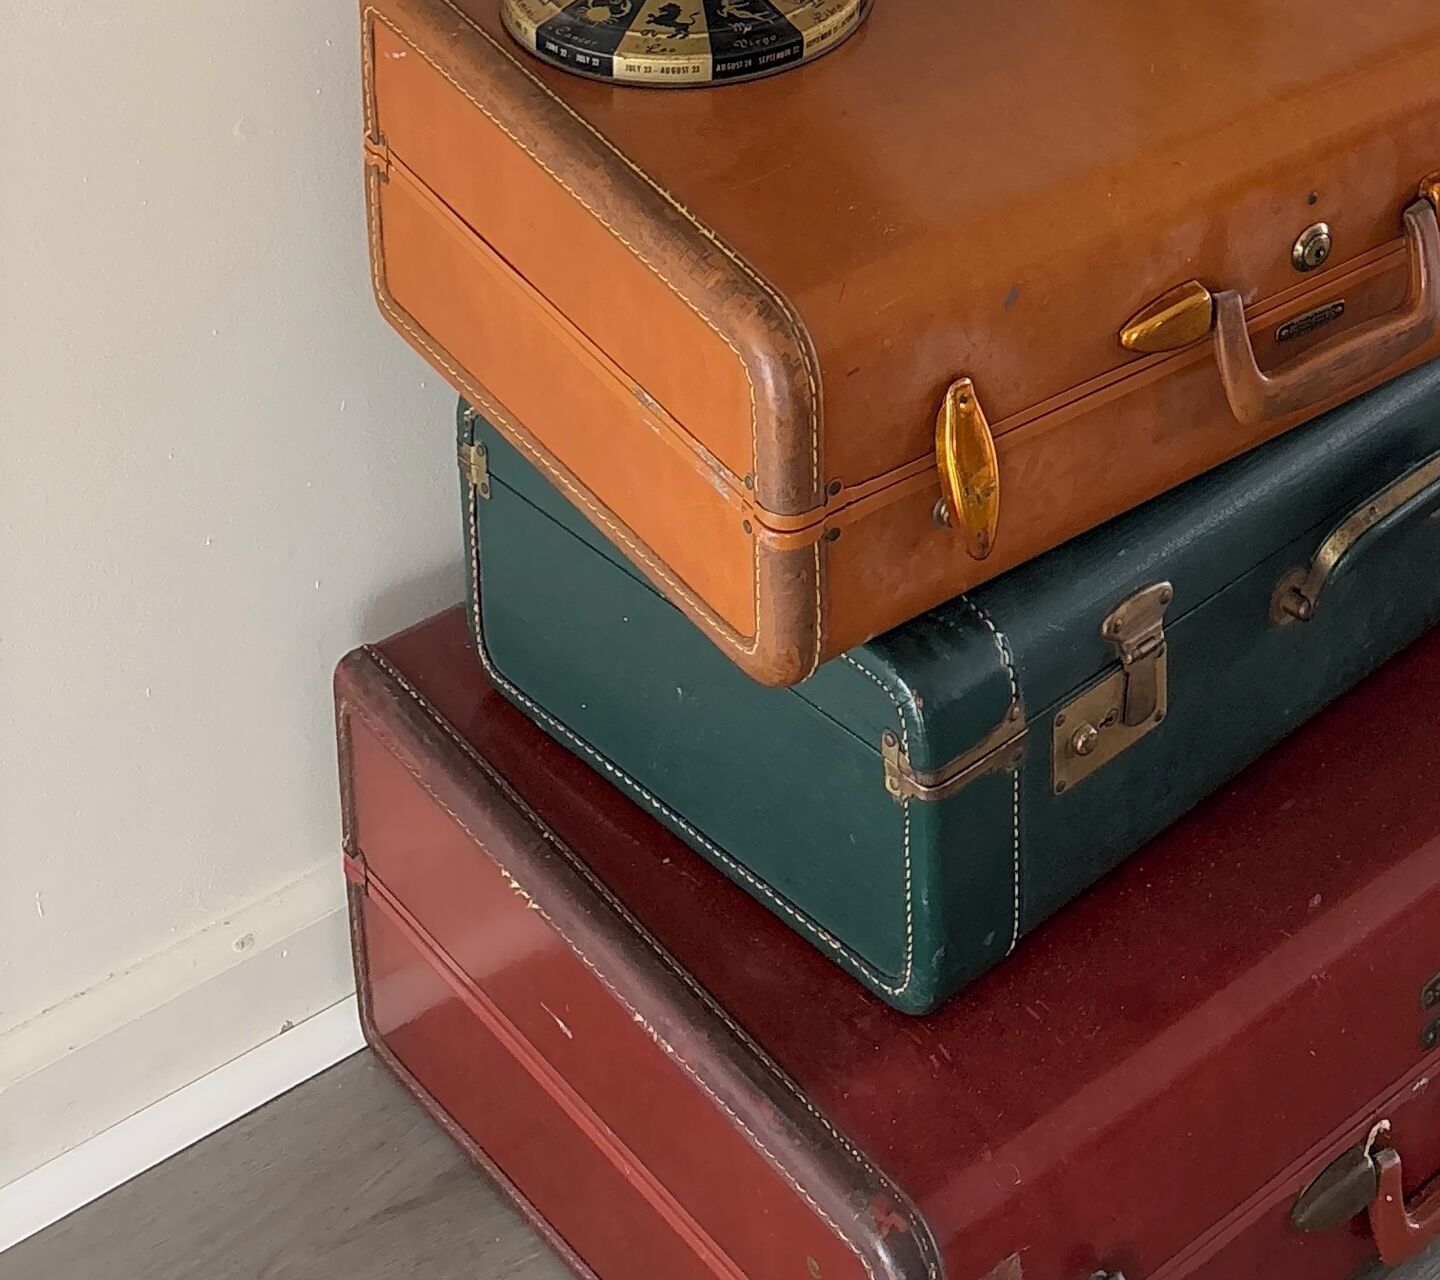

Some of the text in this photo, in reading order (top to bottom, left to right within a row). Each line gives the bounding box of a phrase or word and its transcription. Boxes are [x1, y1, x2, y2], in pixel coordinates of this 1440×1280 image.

[625, 64, 641, 73] JULY
[660, 65, 689, 75] AUGUST
[716, 61, 743, 72] AUGUST
